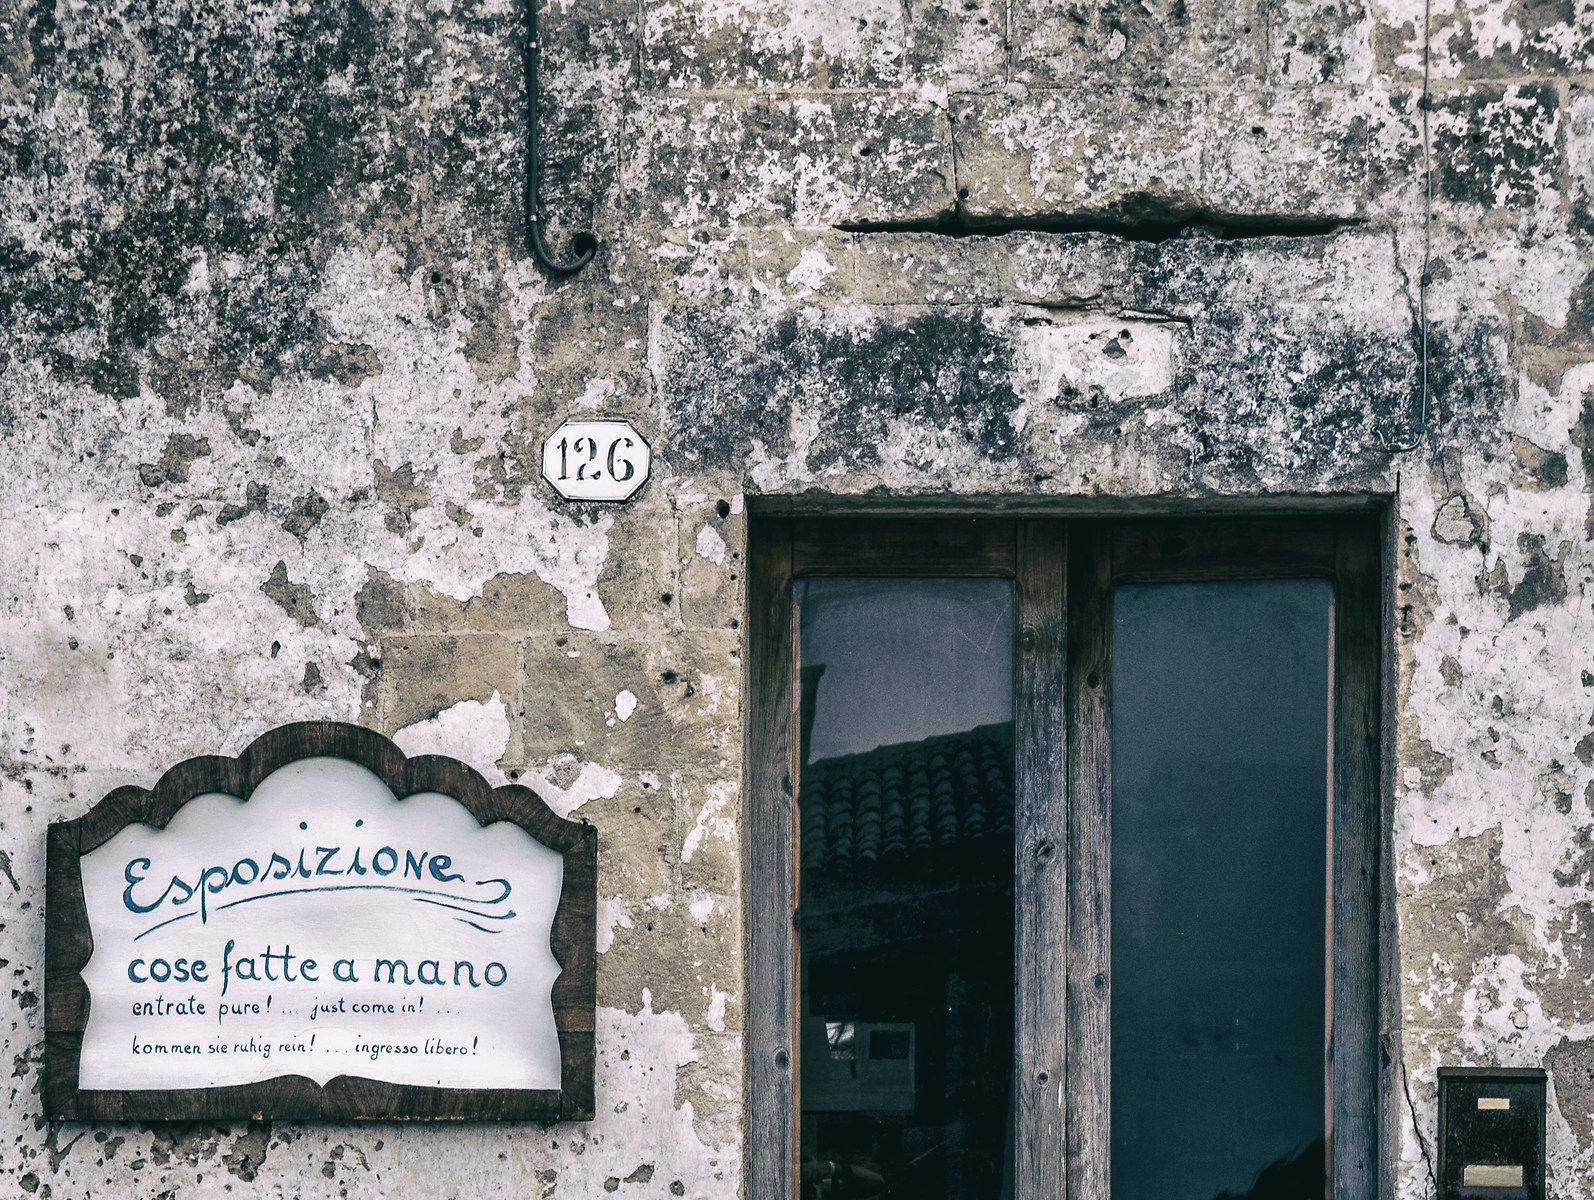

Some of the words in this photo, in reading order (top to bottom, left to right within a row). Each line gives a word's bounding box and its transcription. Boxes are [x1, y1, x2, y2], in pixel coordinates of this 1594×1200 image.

[557, 437, 634, 482] 126
[127, 957, 209, 984] cose
[221, 939, 320, 997] fatte
[332, 959, 359, 983] a
[373, 958, 509, 988] mano
[132, 995, 206, 1016] entrate
[310, 996, 346, 1021] just
[351, 1002, 395, 1014] come
[132, 1035, 201, 1054] kommen
[208, 1035, 228, 1054] sie
[233, 1035, 271, 1059] ruhig
[355, 1034, 418, 1061] ingresso
